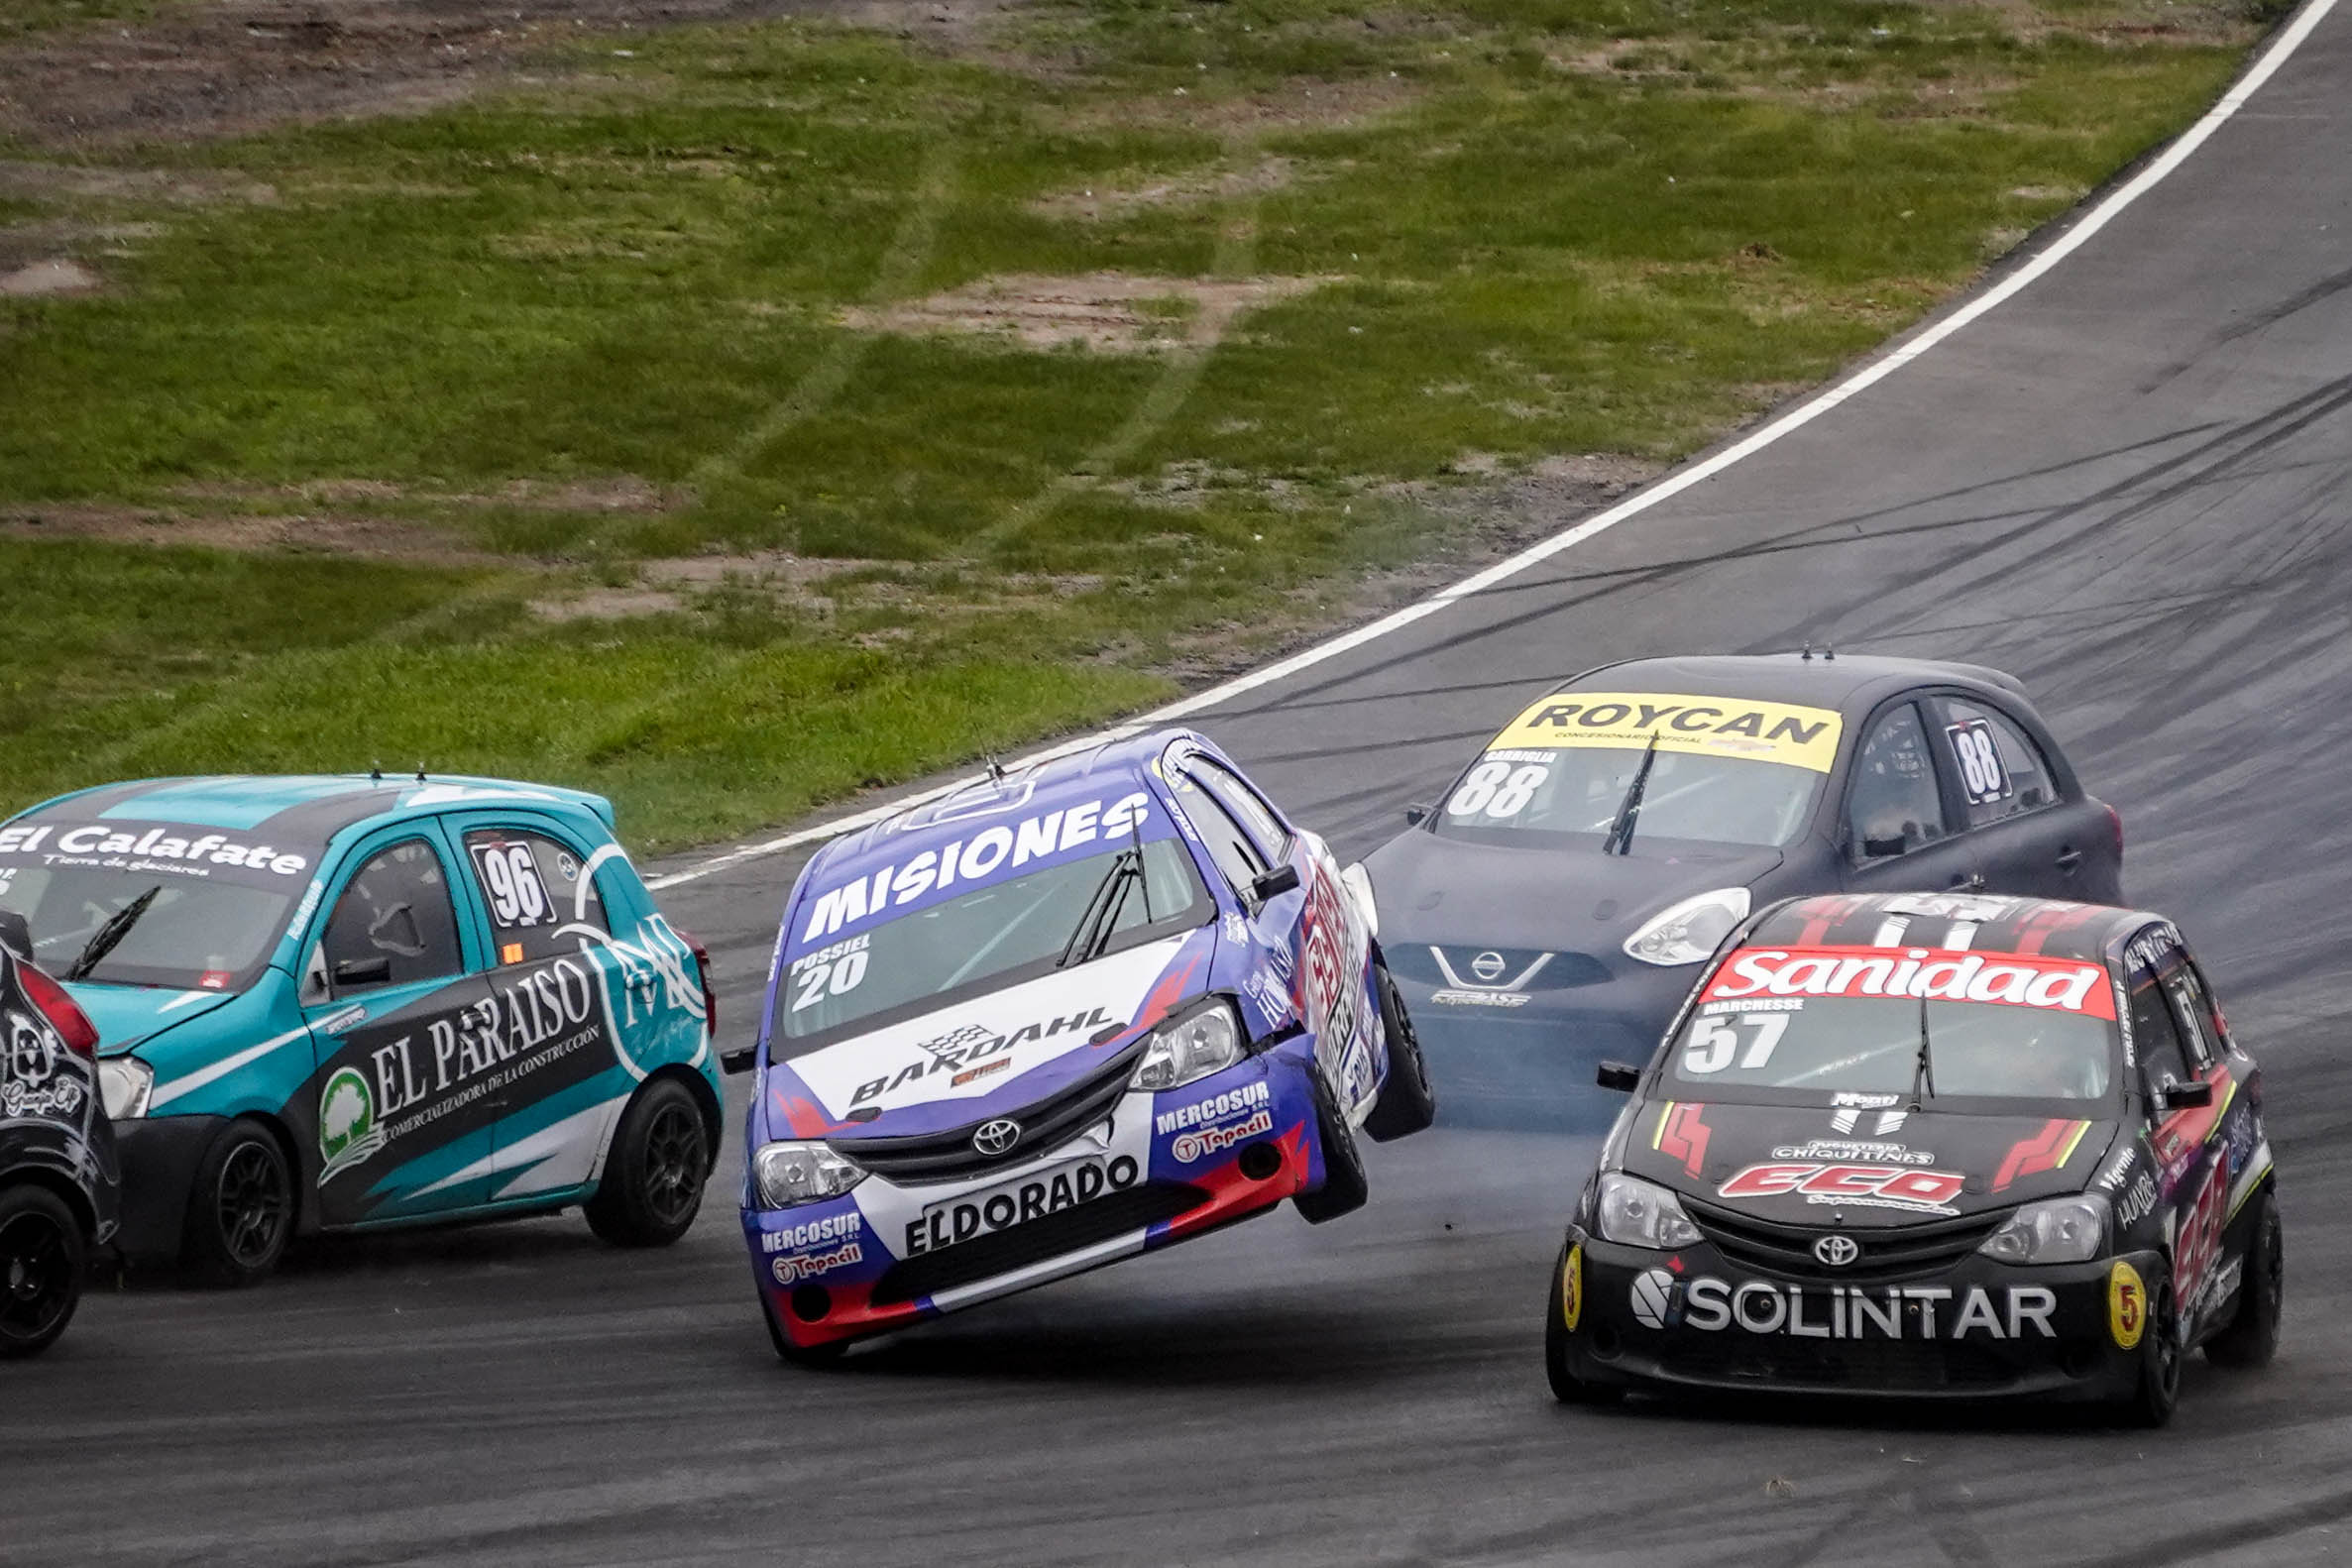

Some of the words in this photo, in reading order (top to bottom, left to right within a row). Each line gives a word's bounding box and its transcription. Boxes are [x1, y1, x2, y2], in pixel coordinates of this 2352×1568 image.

[1526, 703, 1829, 745] ROYCAN
[1448, 761, 1549, 818] 88
[1956, 728, 2002, 794] 88
[0, 826, 54, 852] El
[58, 826, 306, 875] Calafate
[802, 792, 1149, 944] MISIONES
[484, 846, 544, 921] 96
[790, 933, 870, 976] POSSIEL
[791, 951, 869, 1013] 20
[1713, 948, 2099, 1011] Sanidad
[1703, 998, 1804, 1016] MARCHESSE
[371, 1036, 426, 1118] EL
[428, 958, 591, 1091] PARAISO
[848, 1006, 1113, 1108] BARDAHL
[1684, 1013, 1791, 1074] 57
[1156, 1080, 1270, 1135] MERCOSUR
[1718, 1163, 1965, 1206] ECO
[1775, 1147, 1933, 1165] CHIQUITINES
[761, 1212, 861, 1254] MERCOSUR
[904, 1154, 1140, 1257] ELDORADO
[1685, 1279, 2058, 1340] SOLINTAR
[2120, 1284, 2139, 1333] 5
